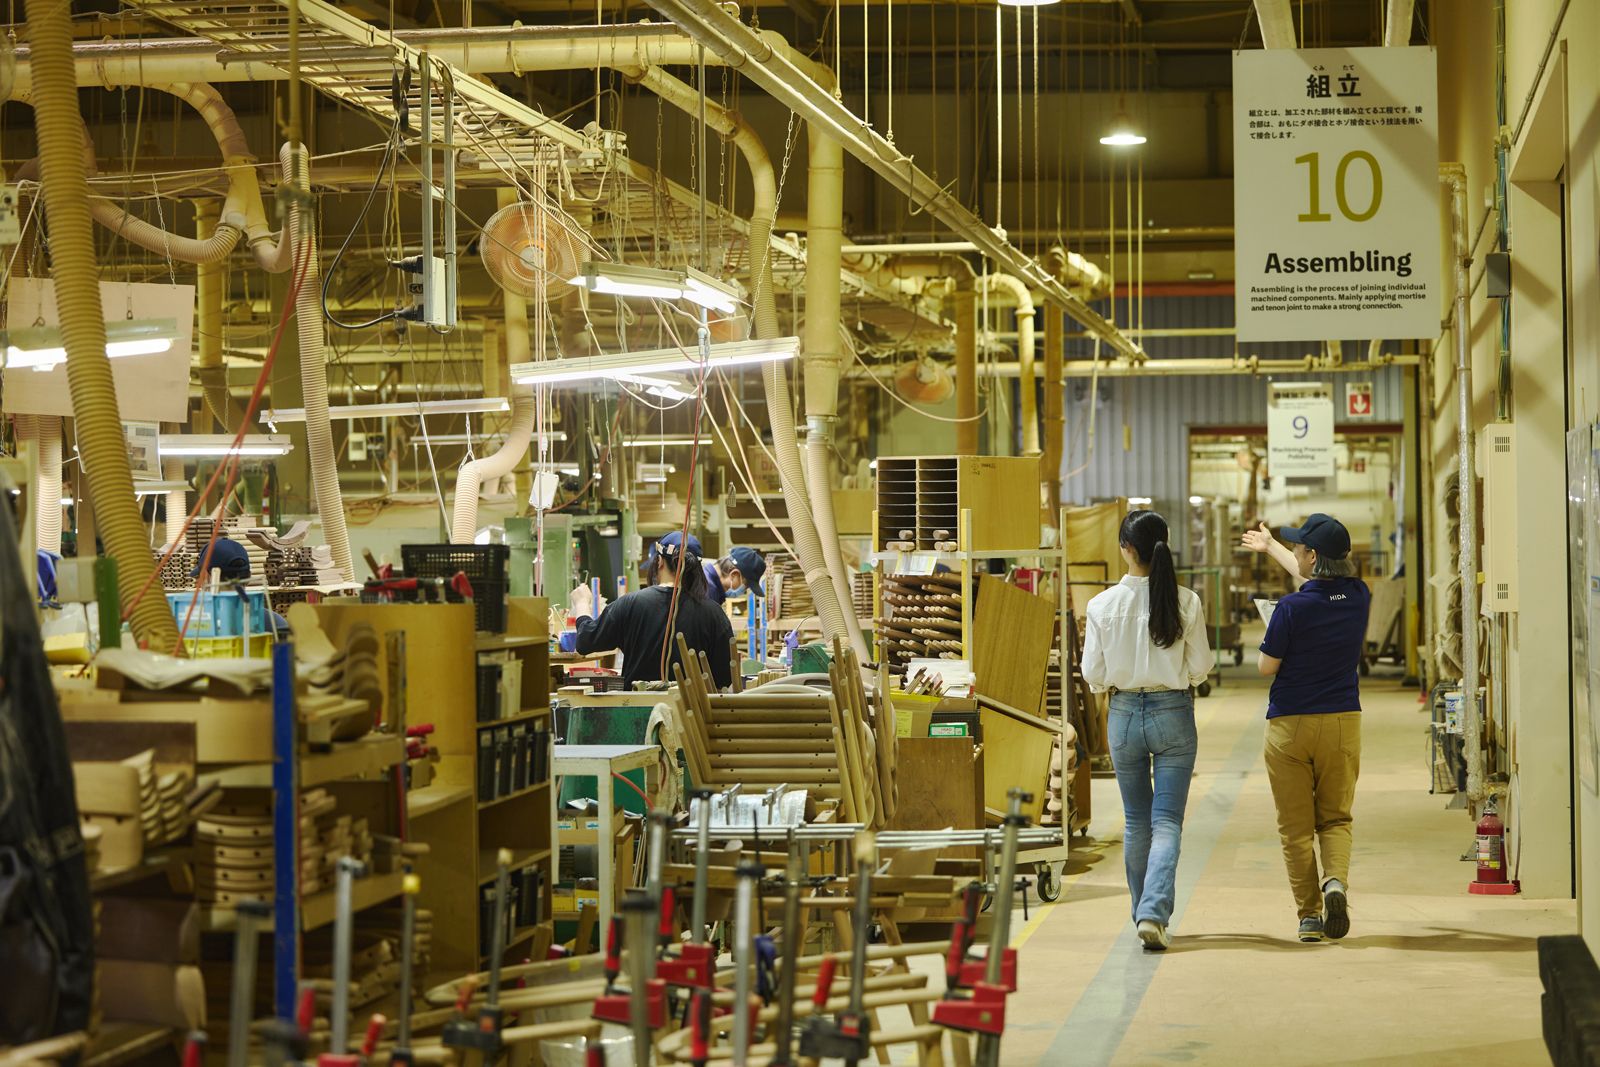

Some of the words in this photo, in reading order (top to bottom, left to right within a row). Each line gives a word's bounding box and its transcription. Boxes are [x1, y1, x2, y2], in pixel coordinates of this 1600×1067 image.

[1306, 73, 1362, 99] 組立
[1295, 150, 1383, 222] 10
[1264, 250, 1412, 277] Assembling
[1250, 295, 1288, 303] machined
[1288, 295, 1337, 303] components.
[1338, 294, 1363, 303] Mainly
[1364, 293, 1397, 302] applying
[1397, 293, 1427, 301] mortise
[1251, 286, 1296, 295] Assembling
[1296, 285, 1304, 293] is
[1304, 285, 1318, 293] the
[1318, 285, 1350, 294] process
[1350, 284, 1360, 292] of
[1359, 284, 1387, 293] joining
[1387, 283, 1427, 292] individual
[1250, 304, 1264, 312] and
[1265, 304, 1287, 312] tenon
[1286, 303, 1303, 312] joint
[1303, 303, 1312, 311] to
[1312, 303, 1332, 311] make
[1338, 303, 1362, 312] strong
[1361, 302, 1403, 310] connection.
[1293, 416, 1308, 439] 9
